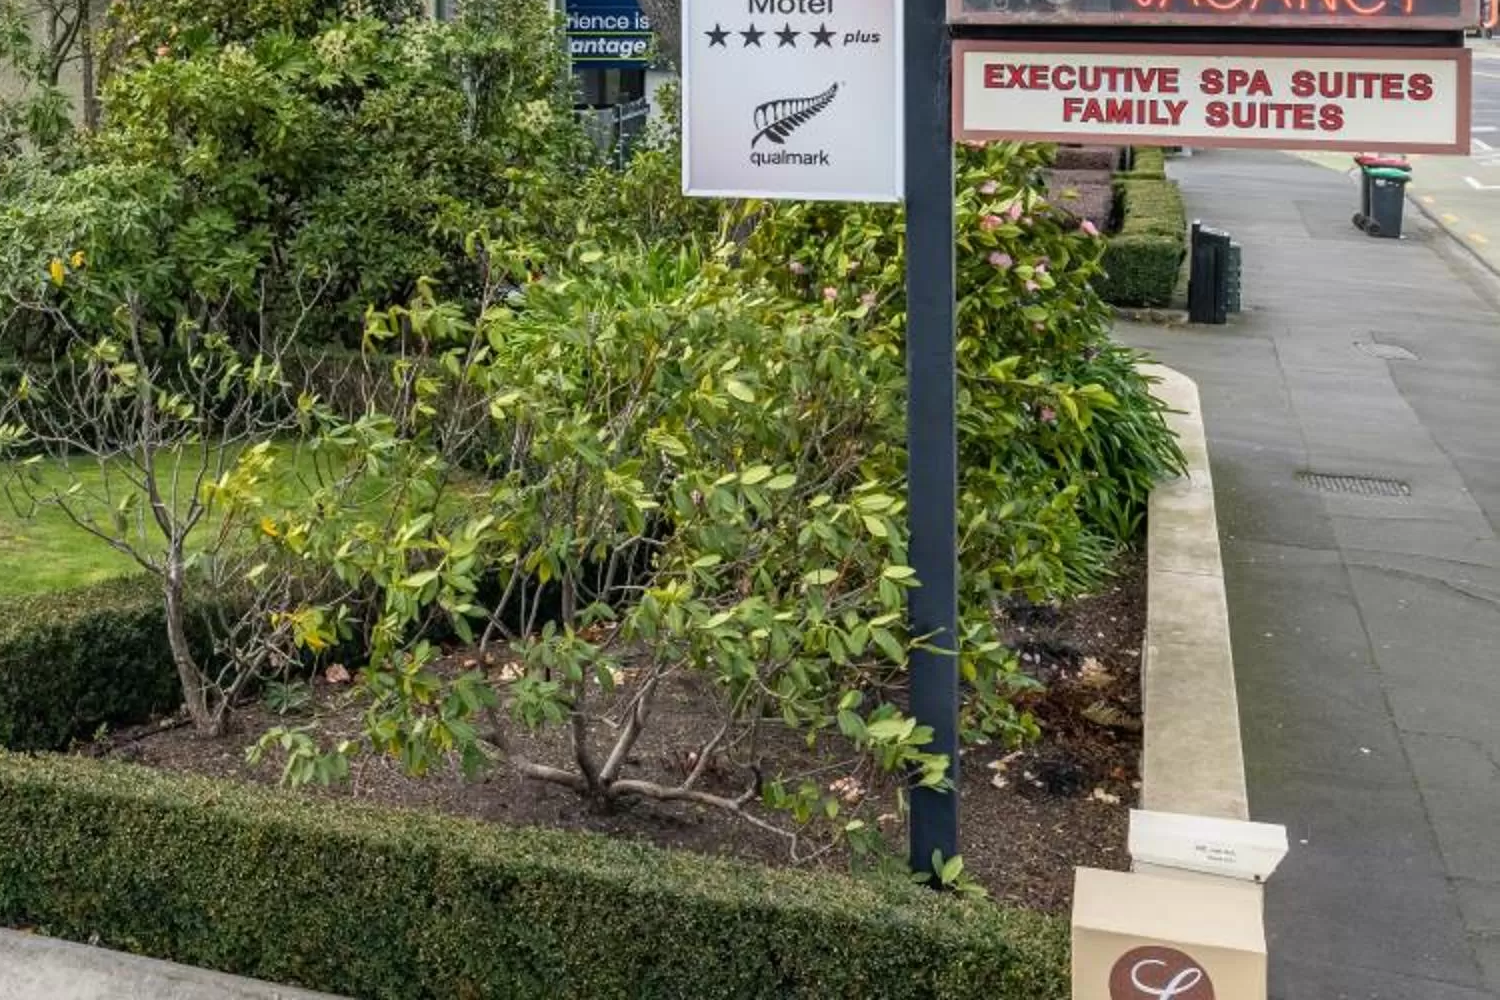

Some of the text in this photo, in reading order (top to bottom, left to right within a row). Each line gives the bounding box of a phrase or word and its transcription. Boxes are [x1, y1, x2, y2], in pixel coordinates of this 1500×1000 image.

[635, 12, 649, 29] is
[843, 29, 881, 46] plus
[983, 63, 1434, 101] EXECUTIVE SPA SUITES
[1062, 97, 1344, 132] FAMILY SUITES
[750, 149, 830, 166] qualmark
